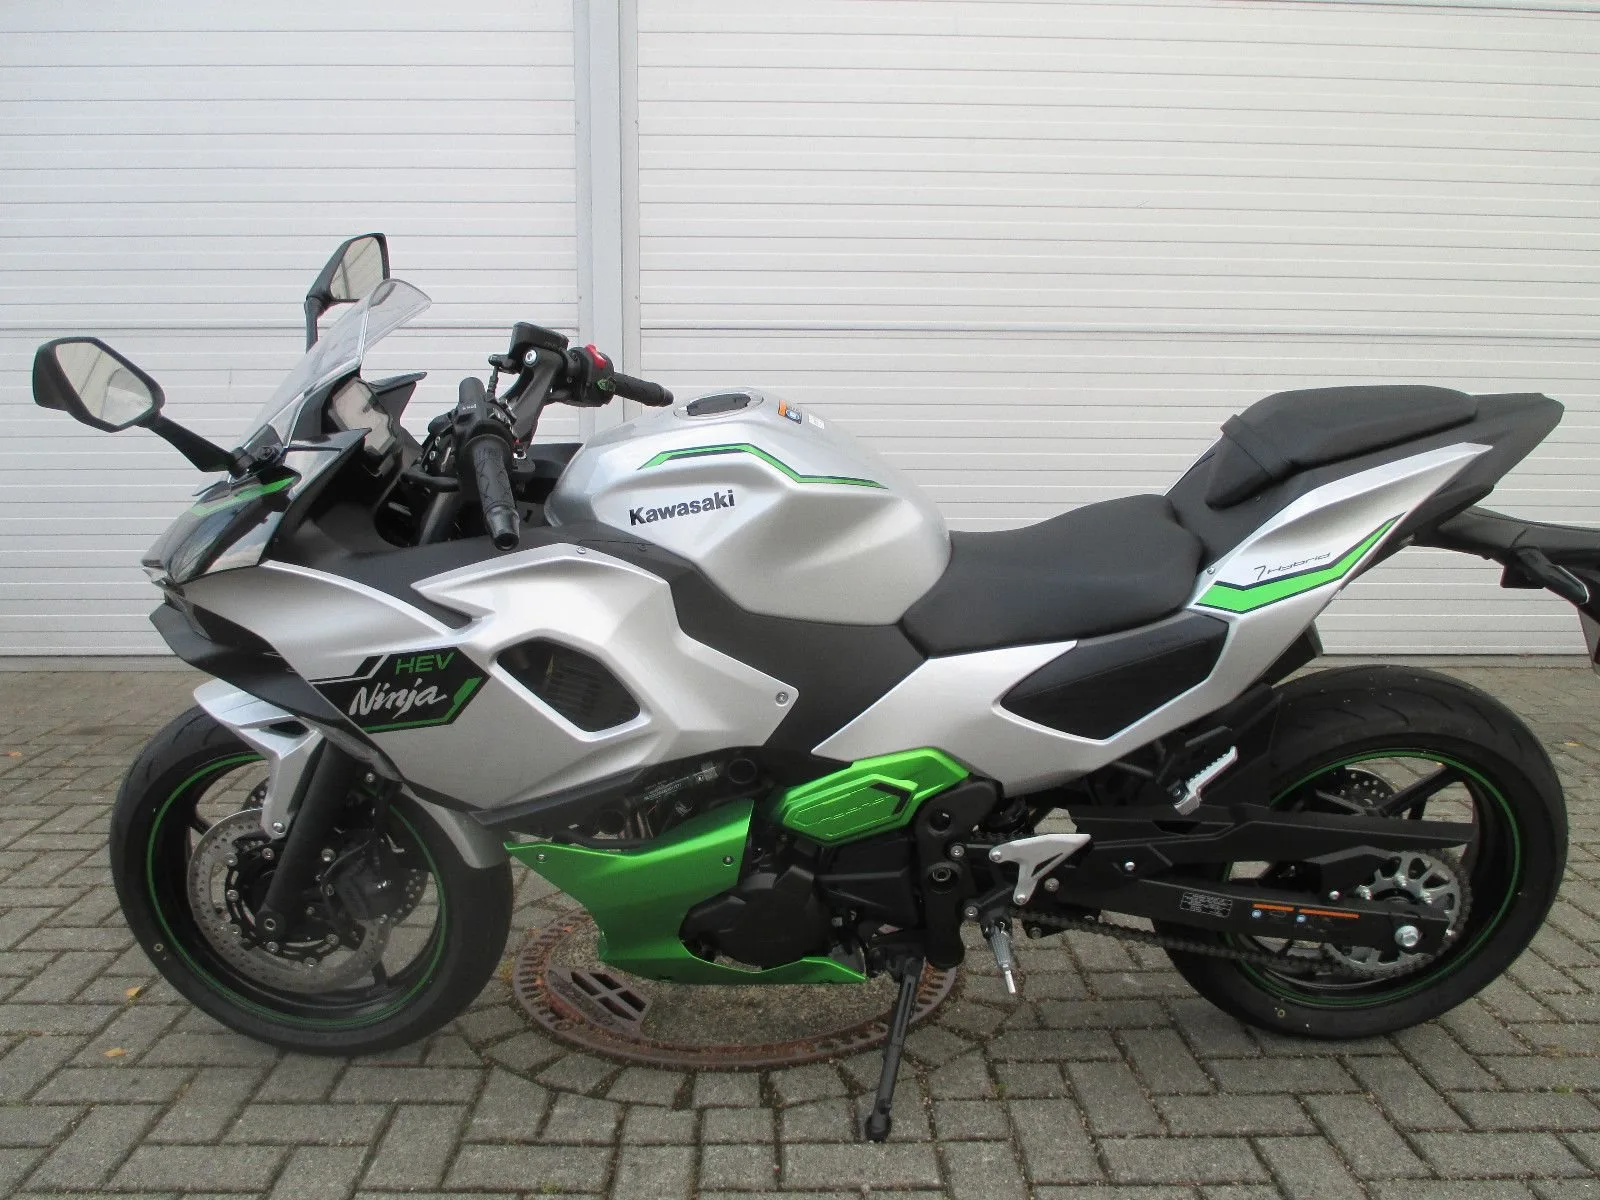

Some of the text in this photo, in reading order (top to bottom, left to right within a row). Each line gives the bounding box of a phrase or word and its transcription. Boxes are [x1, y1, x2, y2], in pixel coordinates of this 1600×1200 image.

[629, 489, 735, 526] Kawasaki
[395, 652, 455, 675] HEV
[348, 677, 448, 719] Ninja
